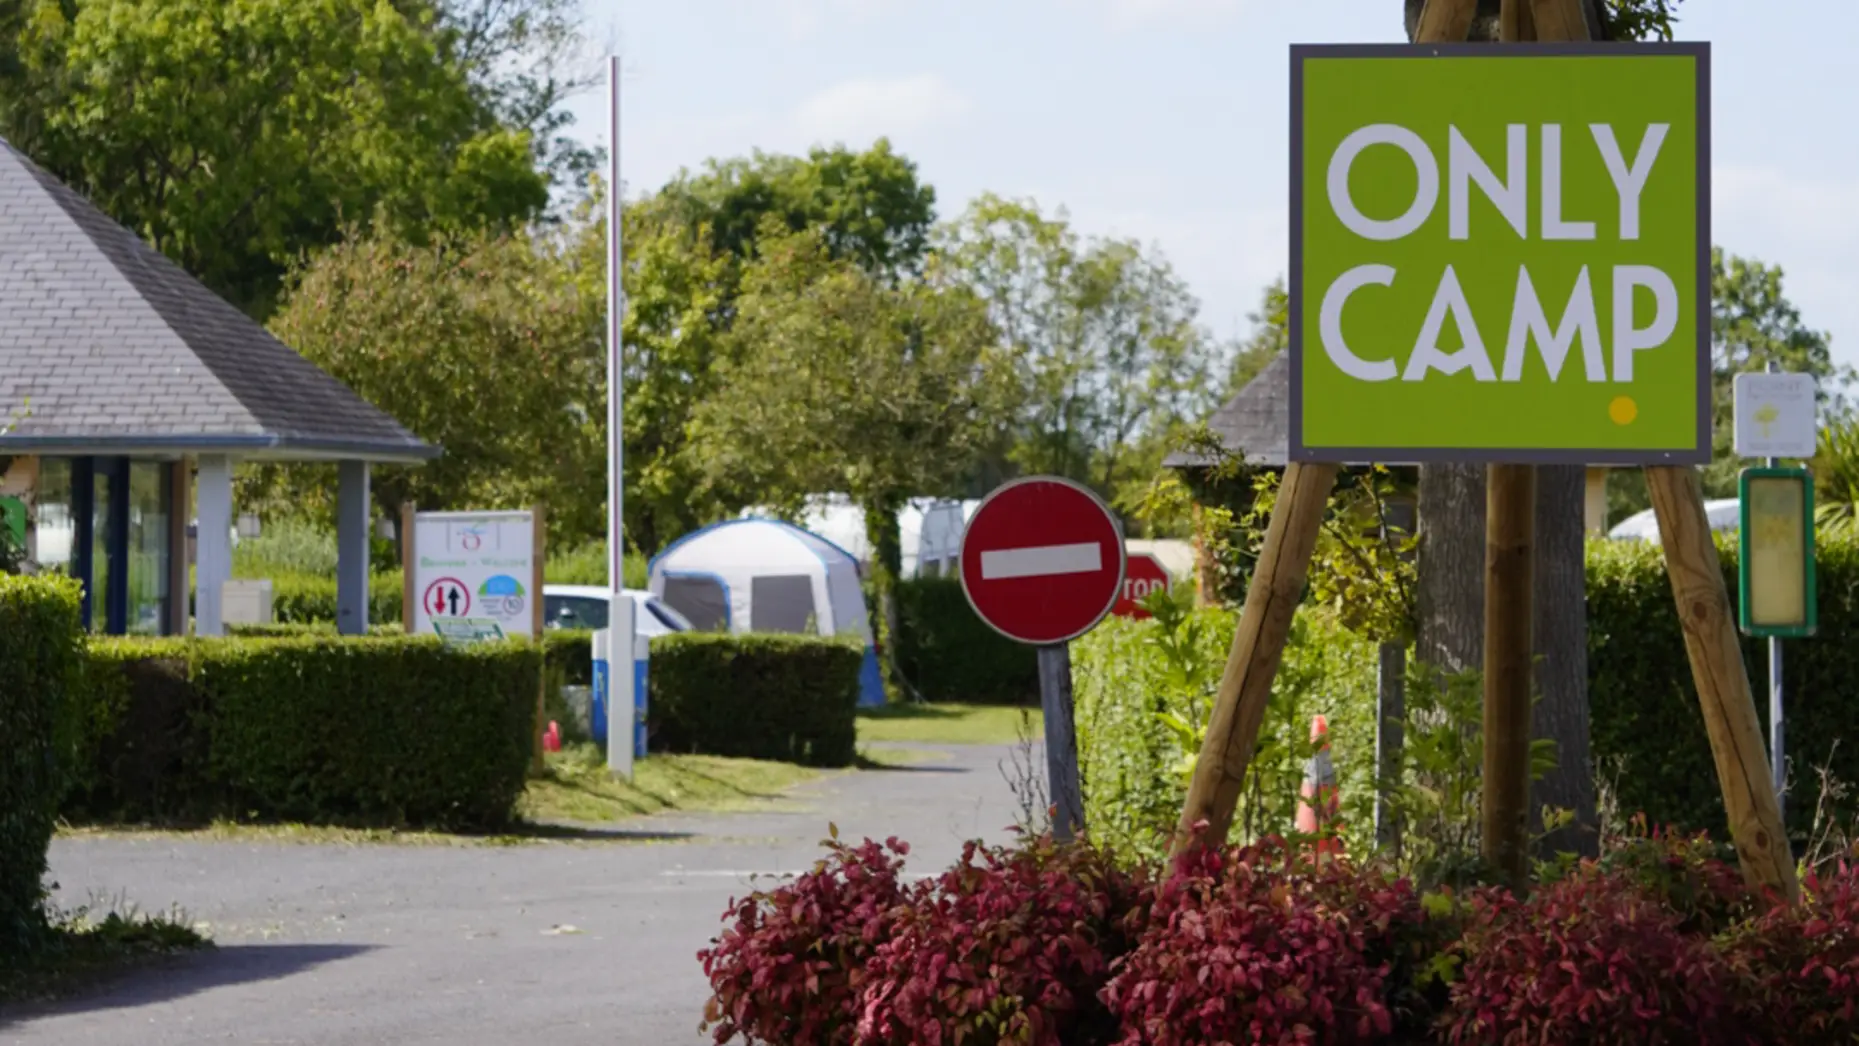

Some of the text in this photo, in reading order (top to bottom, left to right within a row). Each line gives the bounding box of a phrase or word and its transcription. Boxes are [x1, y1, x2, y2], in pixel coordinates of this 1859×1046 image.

[1326, 123, 1671, 241] ONLY
[1319, 263, 1679, 382] CAMP
[1123, 578, 1165, 601] TOP
